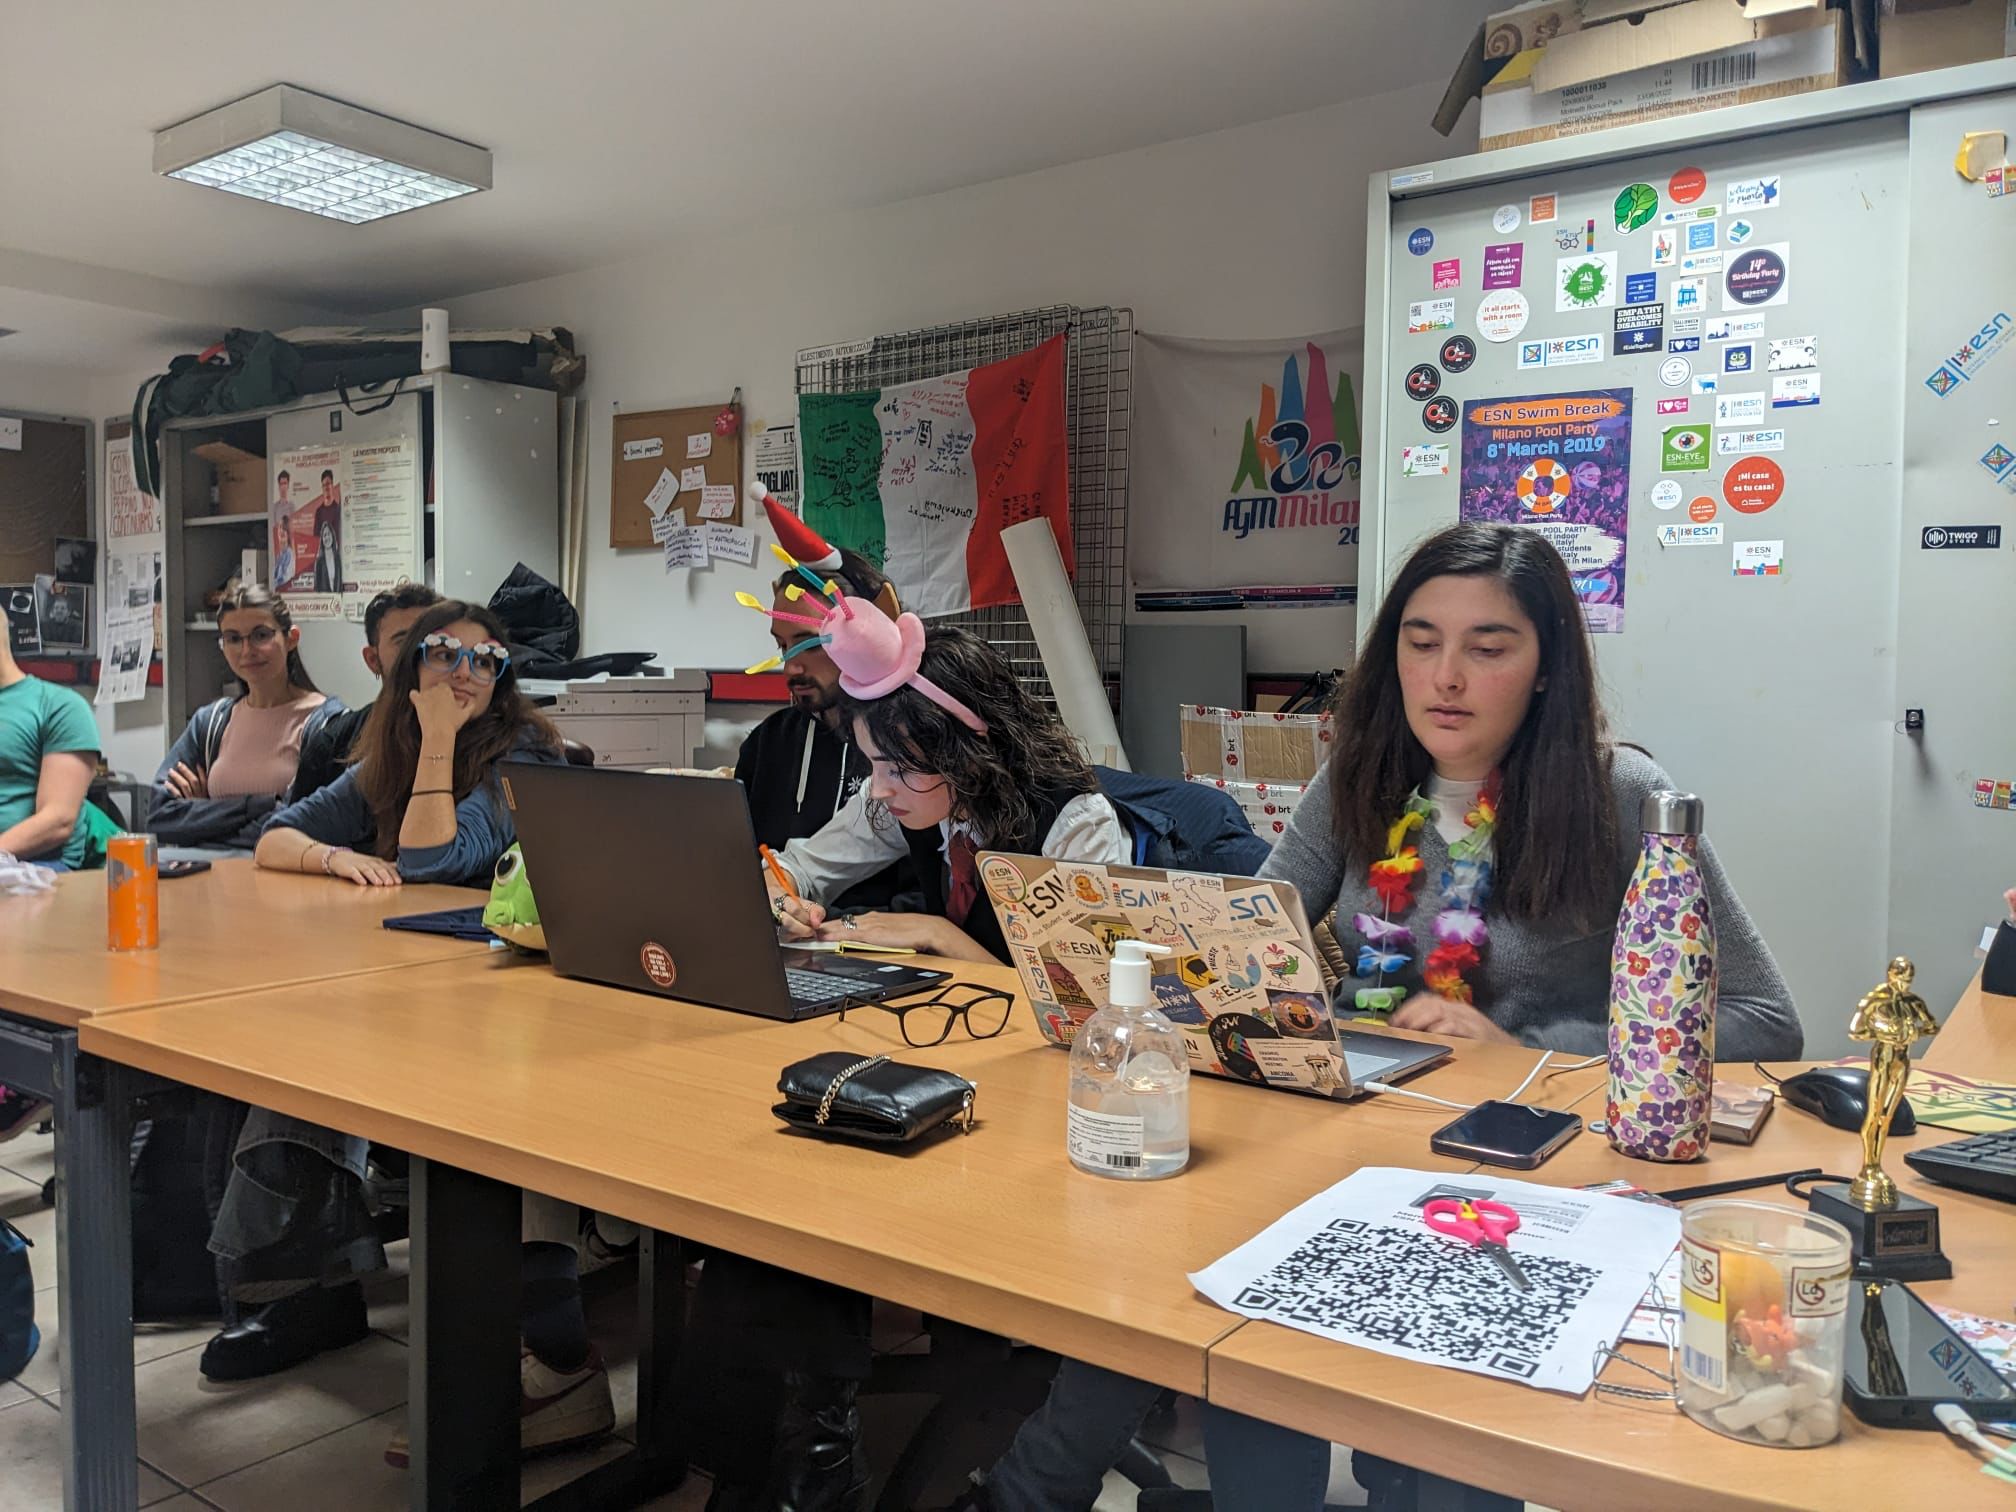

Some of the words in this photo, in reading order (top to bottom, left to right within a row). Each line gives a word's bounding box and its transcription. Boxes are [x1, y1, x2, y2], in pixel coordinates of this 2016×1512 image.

[1417, 235, 1431, 245] ESN
[1732, 271, 1760, 281] Birthday
[1761, 268, 1780, 277] Party
[1439, 301, 1453, 309] ESN
[1500, 303, 1520, 311] starts
[1617, 306, 1662, 317] EMPATHY
[1483, 313, 1498, 322] with
[1504, 312, 1522, 320] room
[1617, 313, 1662, 323] OVERCOMES
[1616, 319, 1662, 330] DISABILITY
[1565, 338, 1598, 351] esn
[1789, 338, 1805, 346] ESN
[1483, 409, 1512, 422] ESN
[1517, 406, 1559, 420] Swim
[1564, 402, 1610, 416] Break
[1492, 428, 1532, 441] Milano
[1535, 425, 1562, 438] Pool
[1565, 423, 1600, 437] Party
[1756, 431, 1782, 441] esn
[1507, 440, 1559, 457] March
[1563, 436, 1606, 453] 2019
[1423, 454, 1440, 462] ESN
[1754, 483, 1774, 491] casa!
[1542, 526, 1563, 534] POOL
[1564, 525, 1588, 533] PARTY
[1693, 526, 1718, 536] esn
[1553, 532, 1579, 540] indoor
[1557, 544, 1592, 552] students
[1561, 551, 1578, 559] Italy
[1581, 556, 1603, 564] Milan
[1207, 707, 1217, 716] brt
[1229, 788, 1241, 797] brt
[1270, 789, 1284, 798] brt
[1240, 804, 1248, 812] rt
[1278, 805, 1292, 814] brt
[994, 867, 1012, 877] ESN
[1206, 879, 1221, 887] ESN
[1022, 874, 1065, 919] ESN
[1070, 941, 1102, 956] ESN
[1207, 946, 1219, 971] TRIESTE
[1031, 966, 1053, 1002] esn
